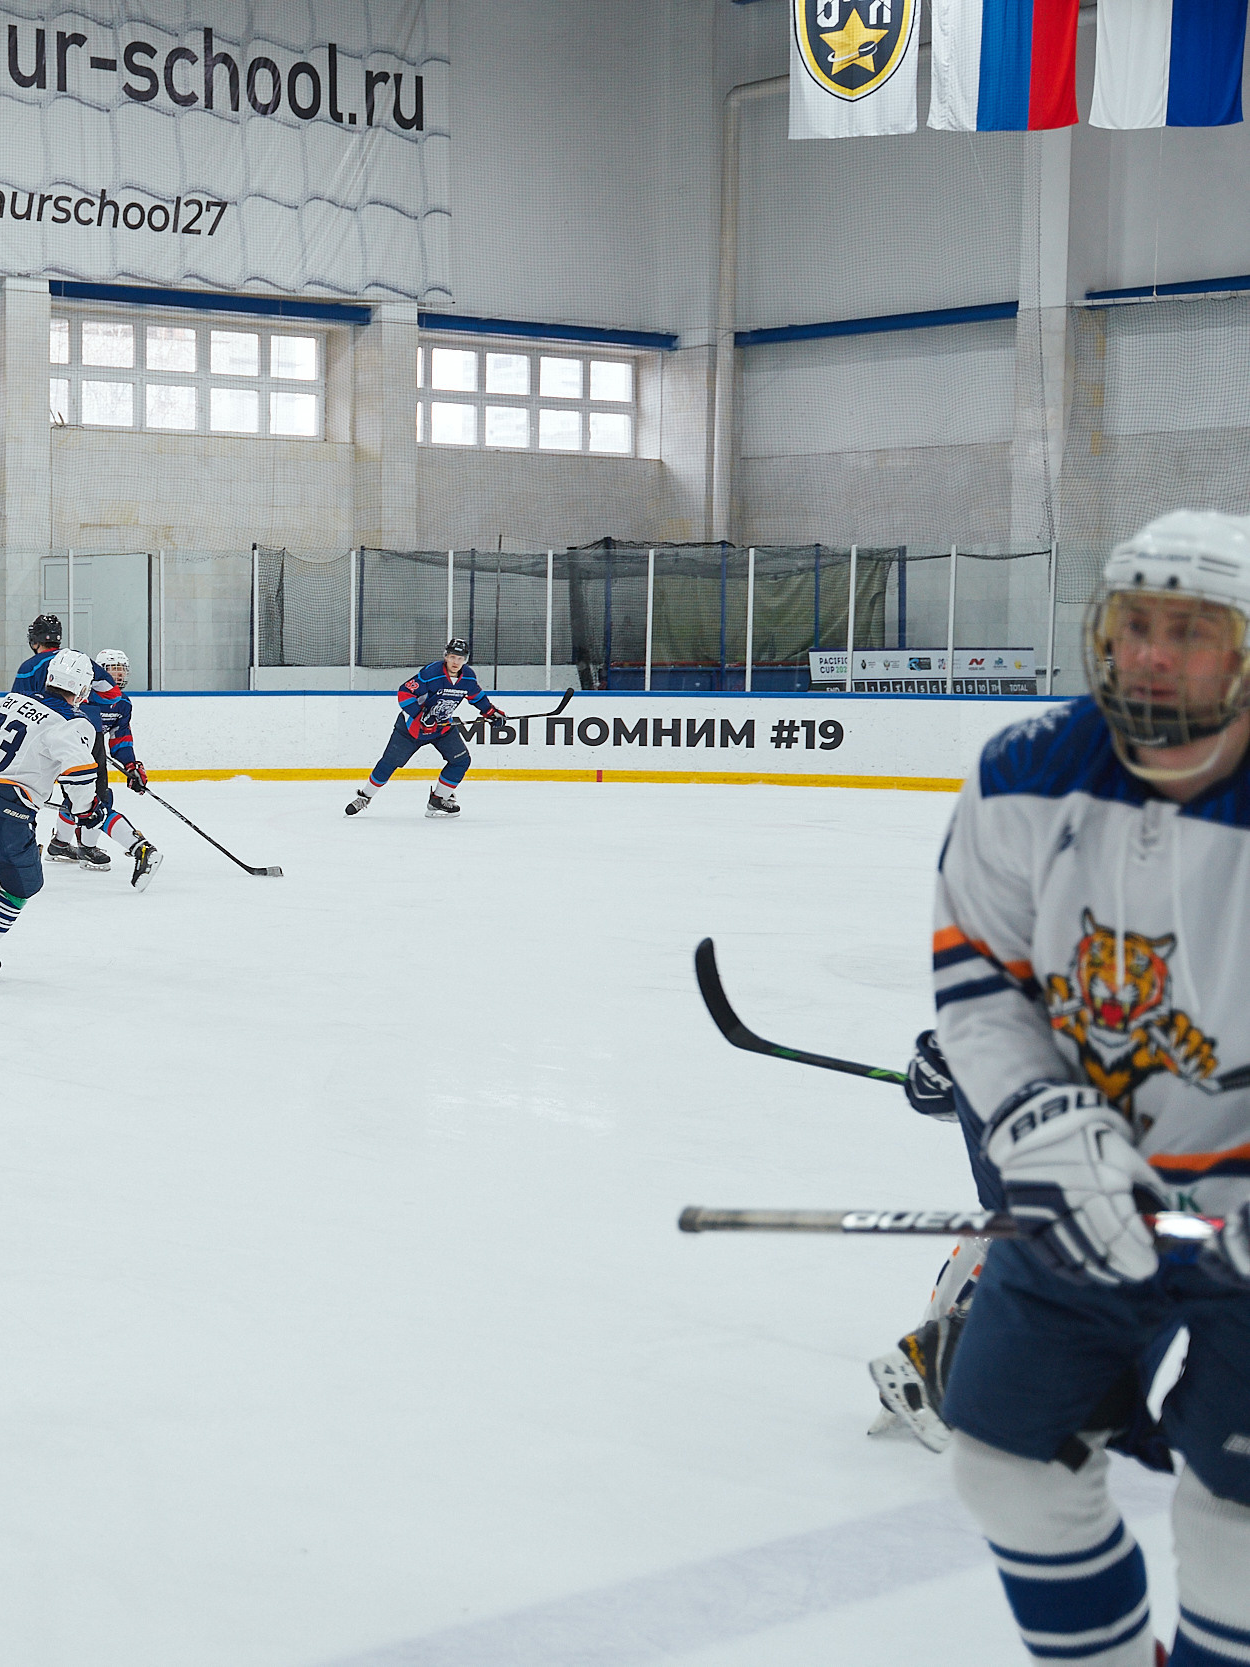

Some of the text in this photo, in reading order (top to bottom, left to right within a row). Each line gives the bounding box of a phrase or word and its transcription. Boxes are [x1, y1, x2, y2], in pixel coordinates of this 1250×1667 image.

[1009, 684, 1029, 692] TOTAL
[17, 701, 50, 725] East
[546, 716, 756, 749] ПОМНИМ
[770, 718, 845, 750] #19
